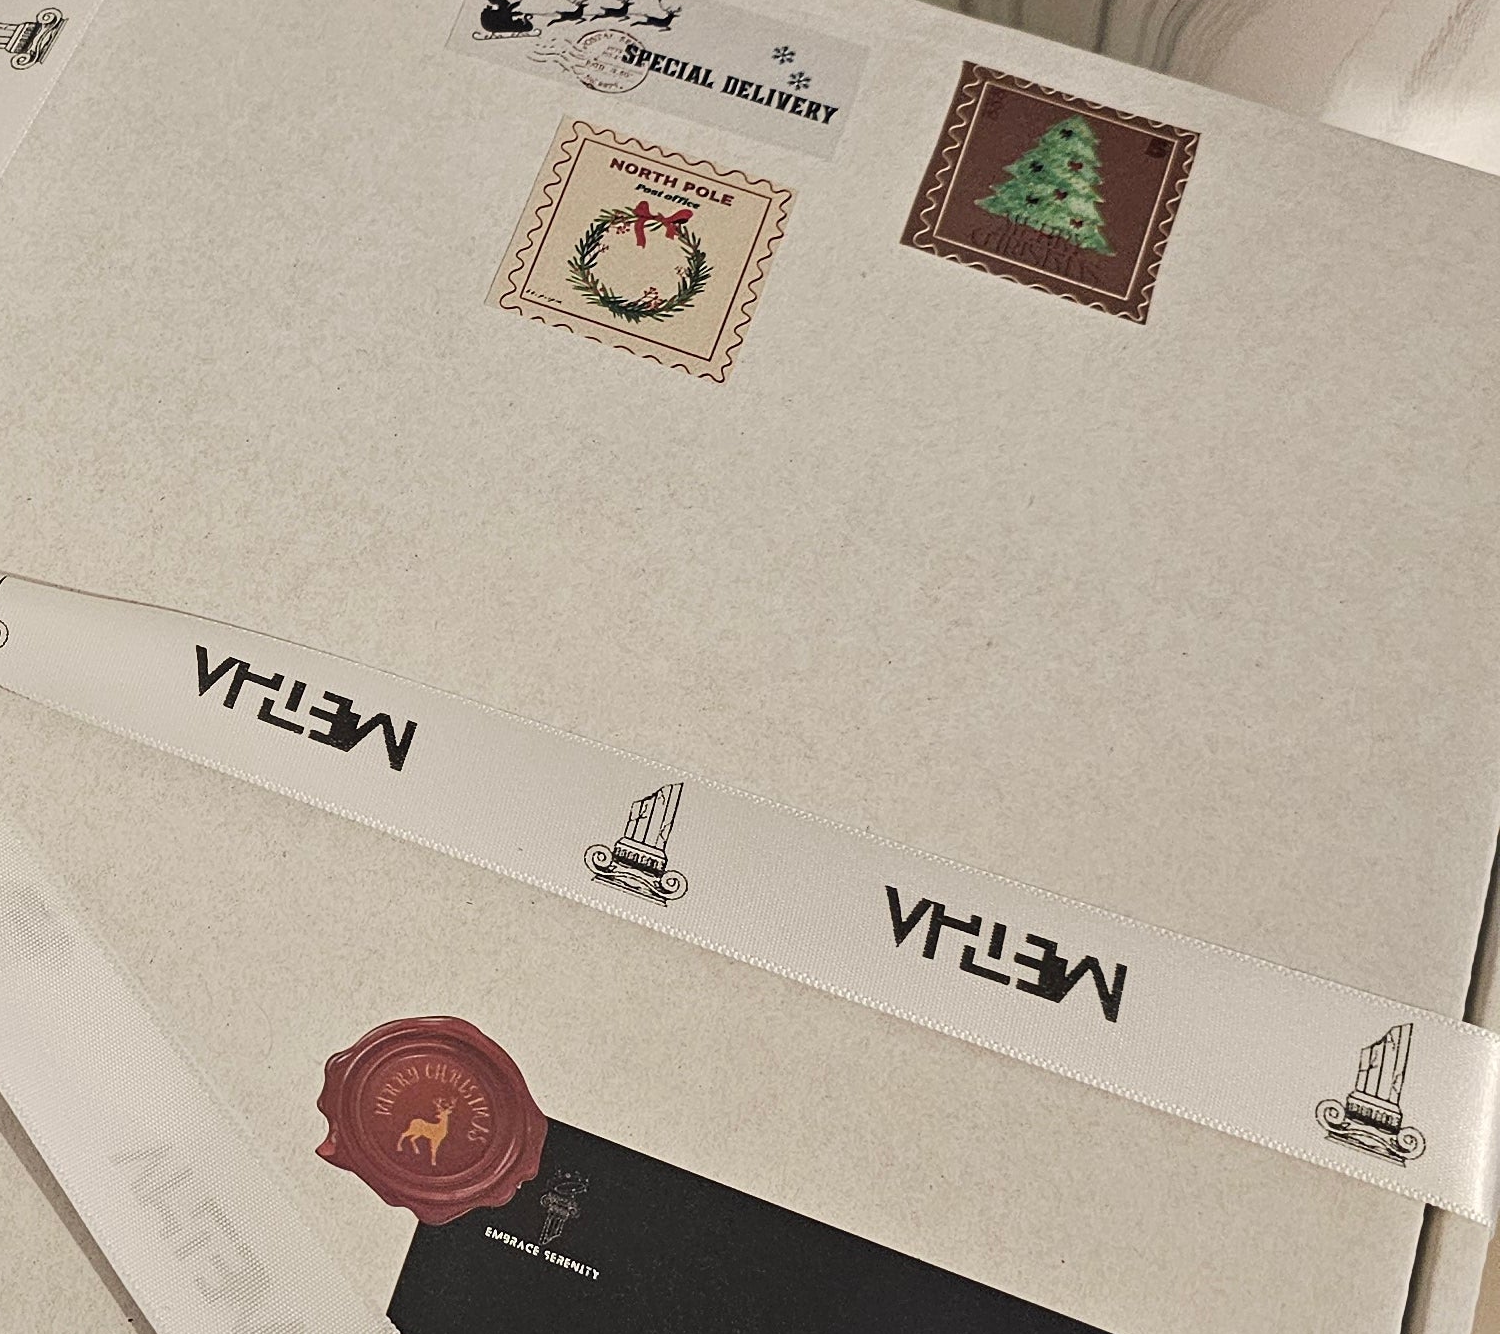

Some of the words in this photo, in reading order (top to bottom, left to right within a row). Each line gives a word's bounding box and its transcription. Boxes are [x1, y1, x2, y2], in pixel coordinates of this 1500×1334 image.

[621, 43, 714, 89] SPECIAL
[721, 75, 840, 125] DELIVERY
[609, 157, 679, 188] NORTH
[682, 181, 735, 207] POLE
[634, 183, 665, 198] Post
[663, 194, 701, 209] office
[375, 1066, 419, 1116] MERRY
[425, 1063, 491, 1144] CHRISTMAS
[484, 1226, 540, 1257] EMBRACE
[543, 1250, 600, 1280] SERENITY
